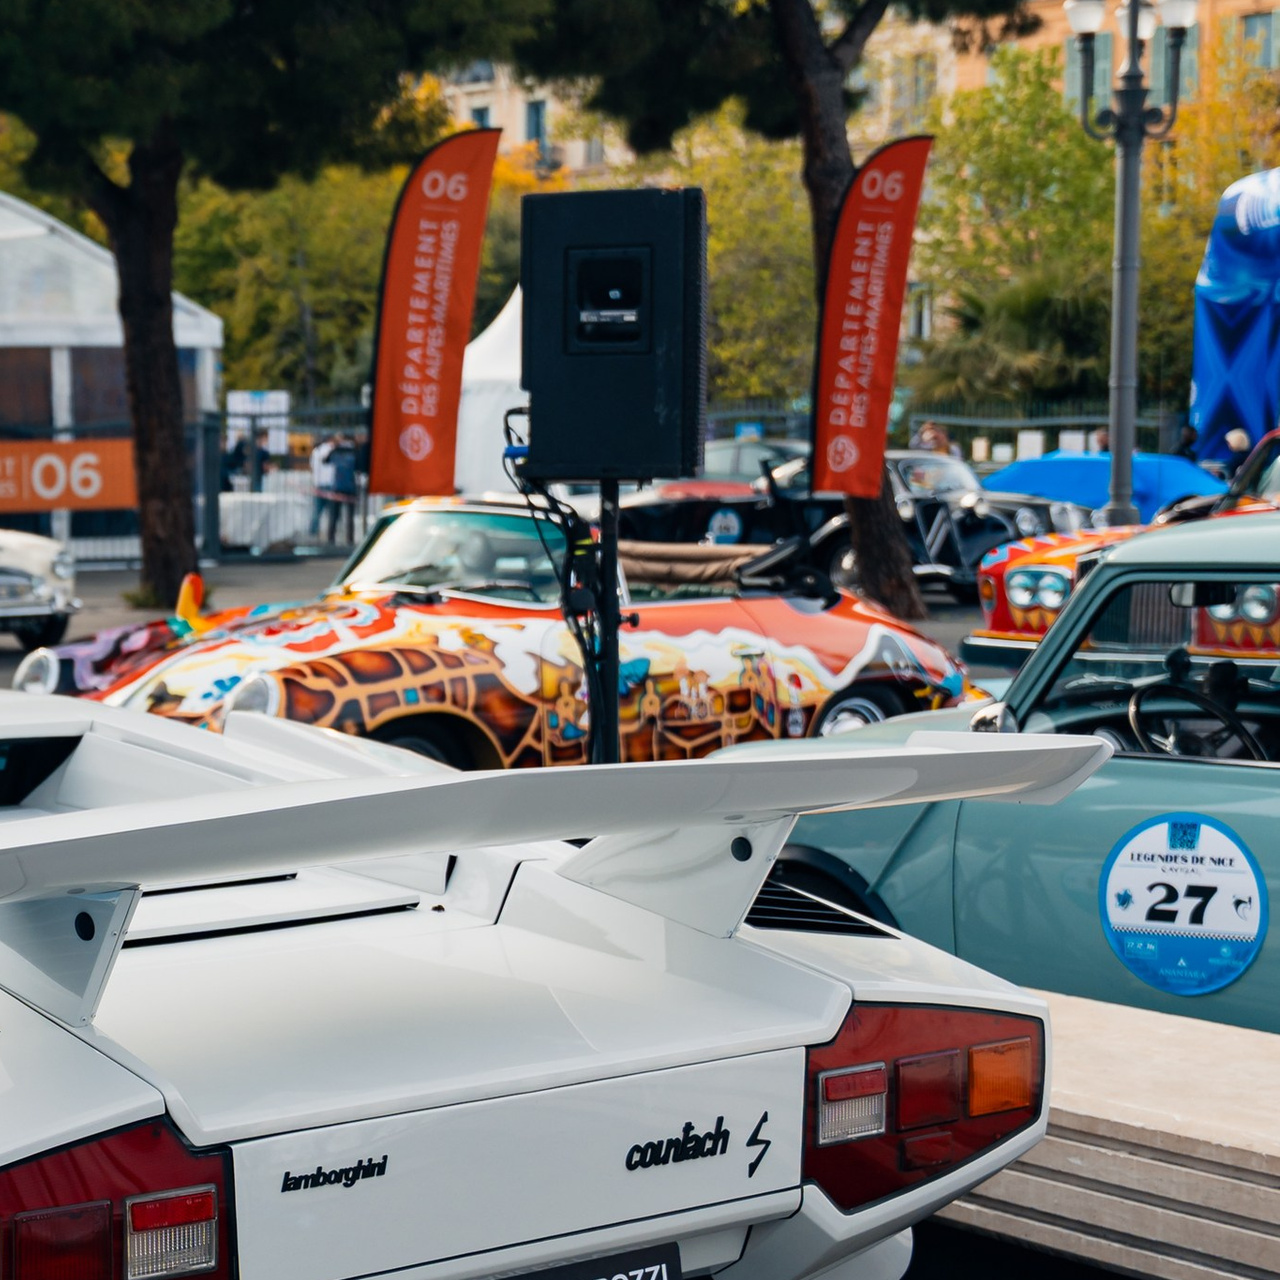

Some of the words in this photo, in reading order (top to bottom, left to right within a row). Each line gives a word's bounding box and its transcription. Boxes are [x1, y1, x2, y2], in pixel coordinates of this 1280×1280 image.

[422, 170, 468, 202] 06
[861, 170, 904, 202] 06
[400, 219, 439, 415] DÉPARTEMENT
[422, 384, 441, 417] DES
[849, 391, 869, 428] DES
[32, 452, 103, 499] 06
[1130, 852, 1188, 866] LEGENDES
[1191, 855, 1206, 866] DE
[1209, 857, 1236, 868] NICE
[1145, 882, 1219, 926] 27
[625, 1115, 730, 1172] countach
[281, 1155, 388, 1193] lamborghini
